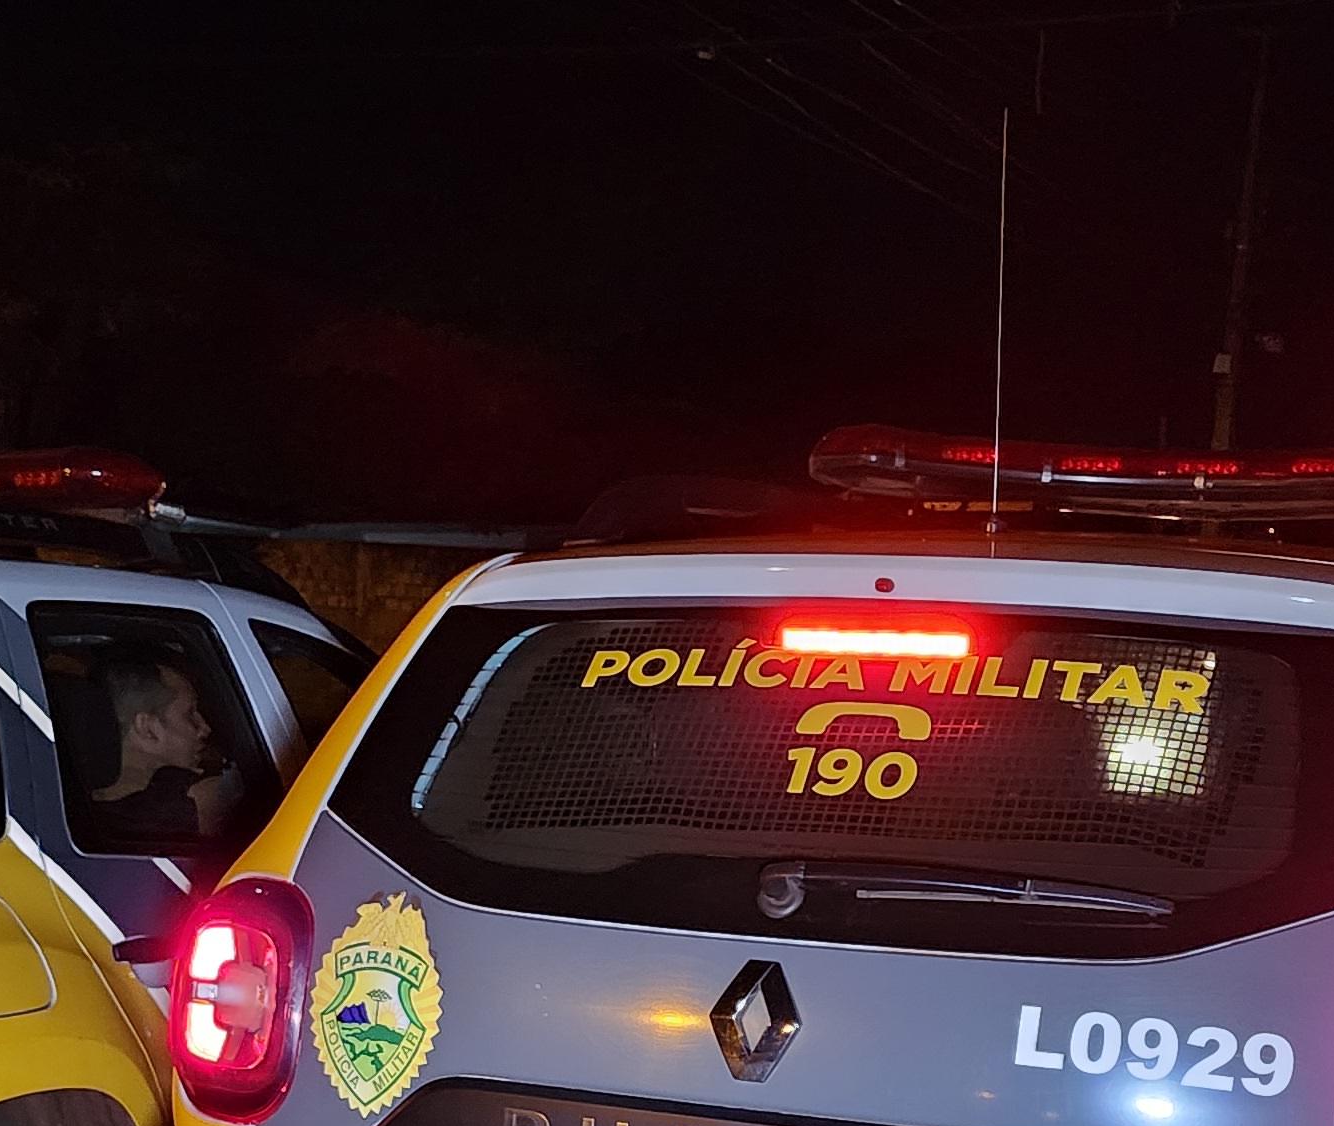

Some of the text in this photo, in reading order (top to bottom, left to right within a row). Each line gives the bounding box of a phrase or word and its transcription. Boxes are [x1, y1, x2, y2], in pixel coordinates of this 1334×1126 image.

[581, 639, 1212, 714] POLÍCIA MILITAR
[786, 747, 919, 800] 190
[338, 950, 423, 979] PARANÁ
[324, 1018, 360, 1090] POLÍCIA
[371, 1031, 419, 1092] MILITAR
[1014, 1004, 1295, 1097] L0929
